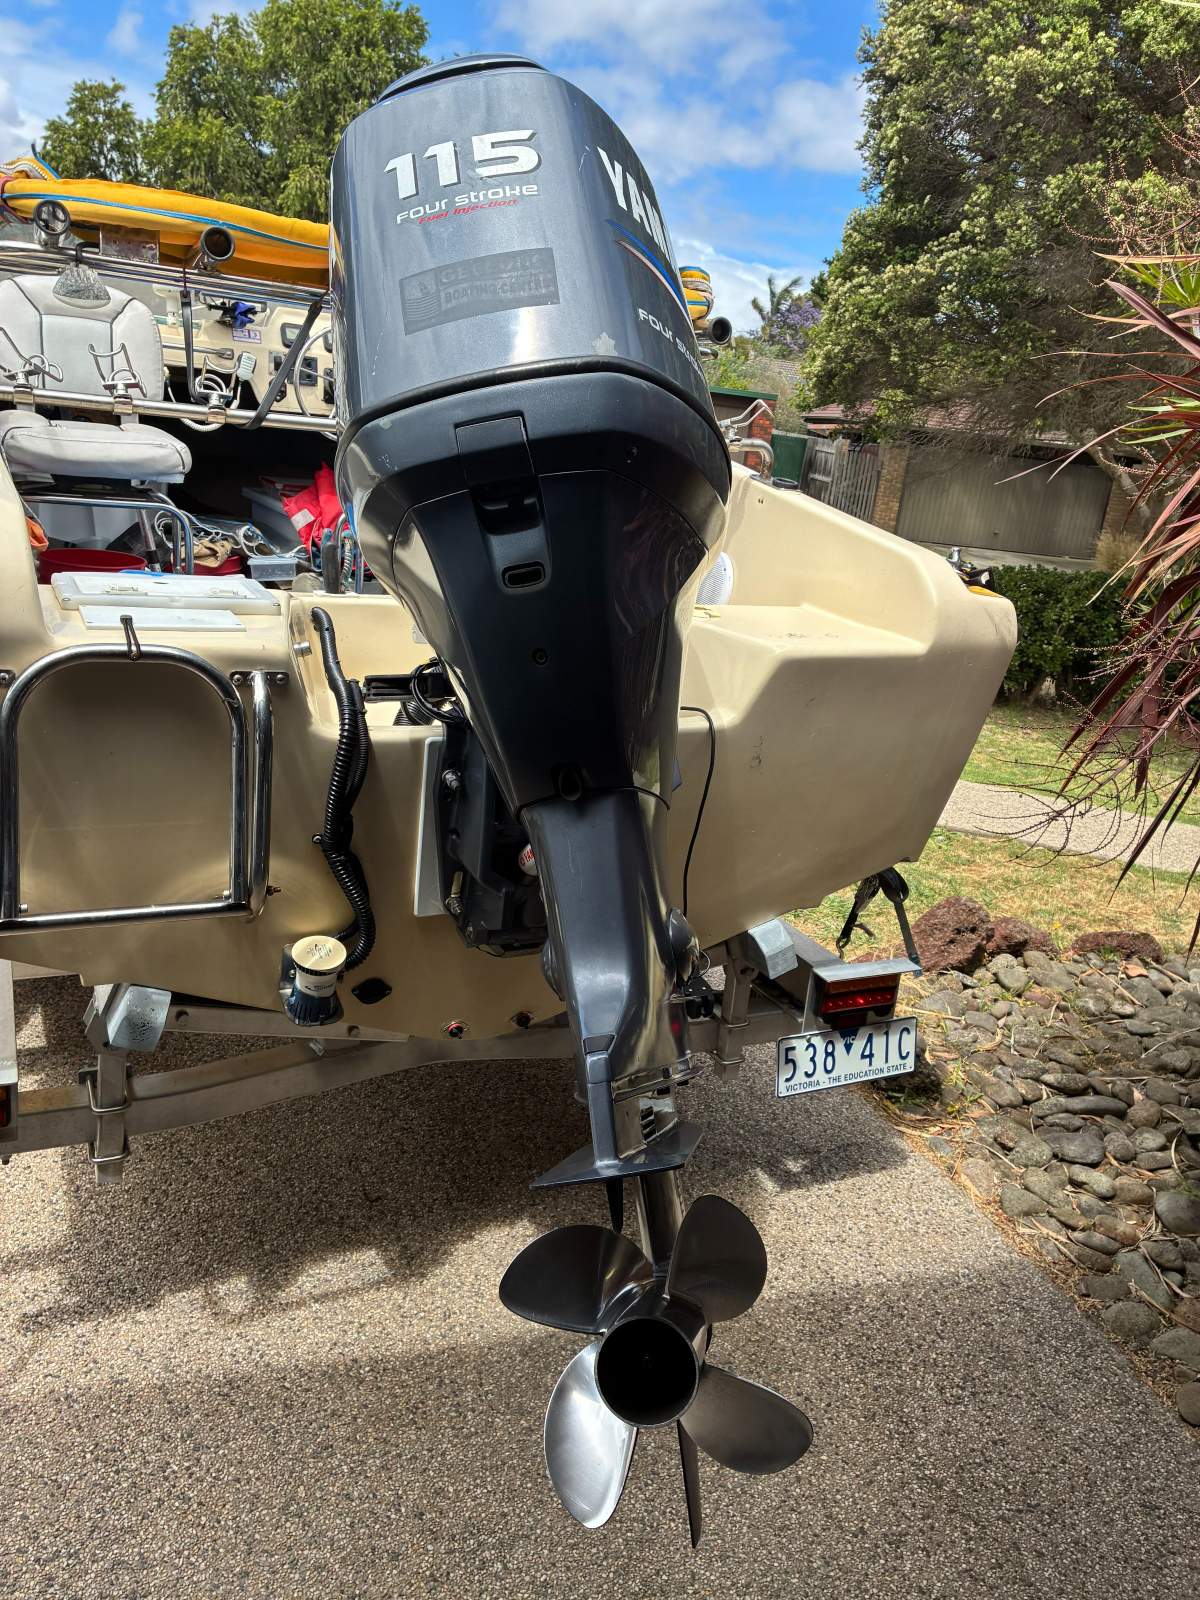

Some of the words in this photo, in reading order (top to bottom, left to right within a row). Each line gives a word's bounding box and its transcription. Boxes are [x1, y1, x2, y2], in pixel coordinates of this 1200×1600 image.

[384, 130, 542, 200] 115
[418, 210, 449, 224] Fuel
[452, 199, 519, 216] Injection
[784, 1039, 836, 1082] 538
[860, 1027, 911, 1066] 41C
[785, 1081, 821, 1093] VICTORIA
[828, 1075, 842, 1085] THE
[844, 1067, 886, 1083] EDUCATION
[886, 1064, 907, 1074] STATE
